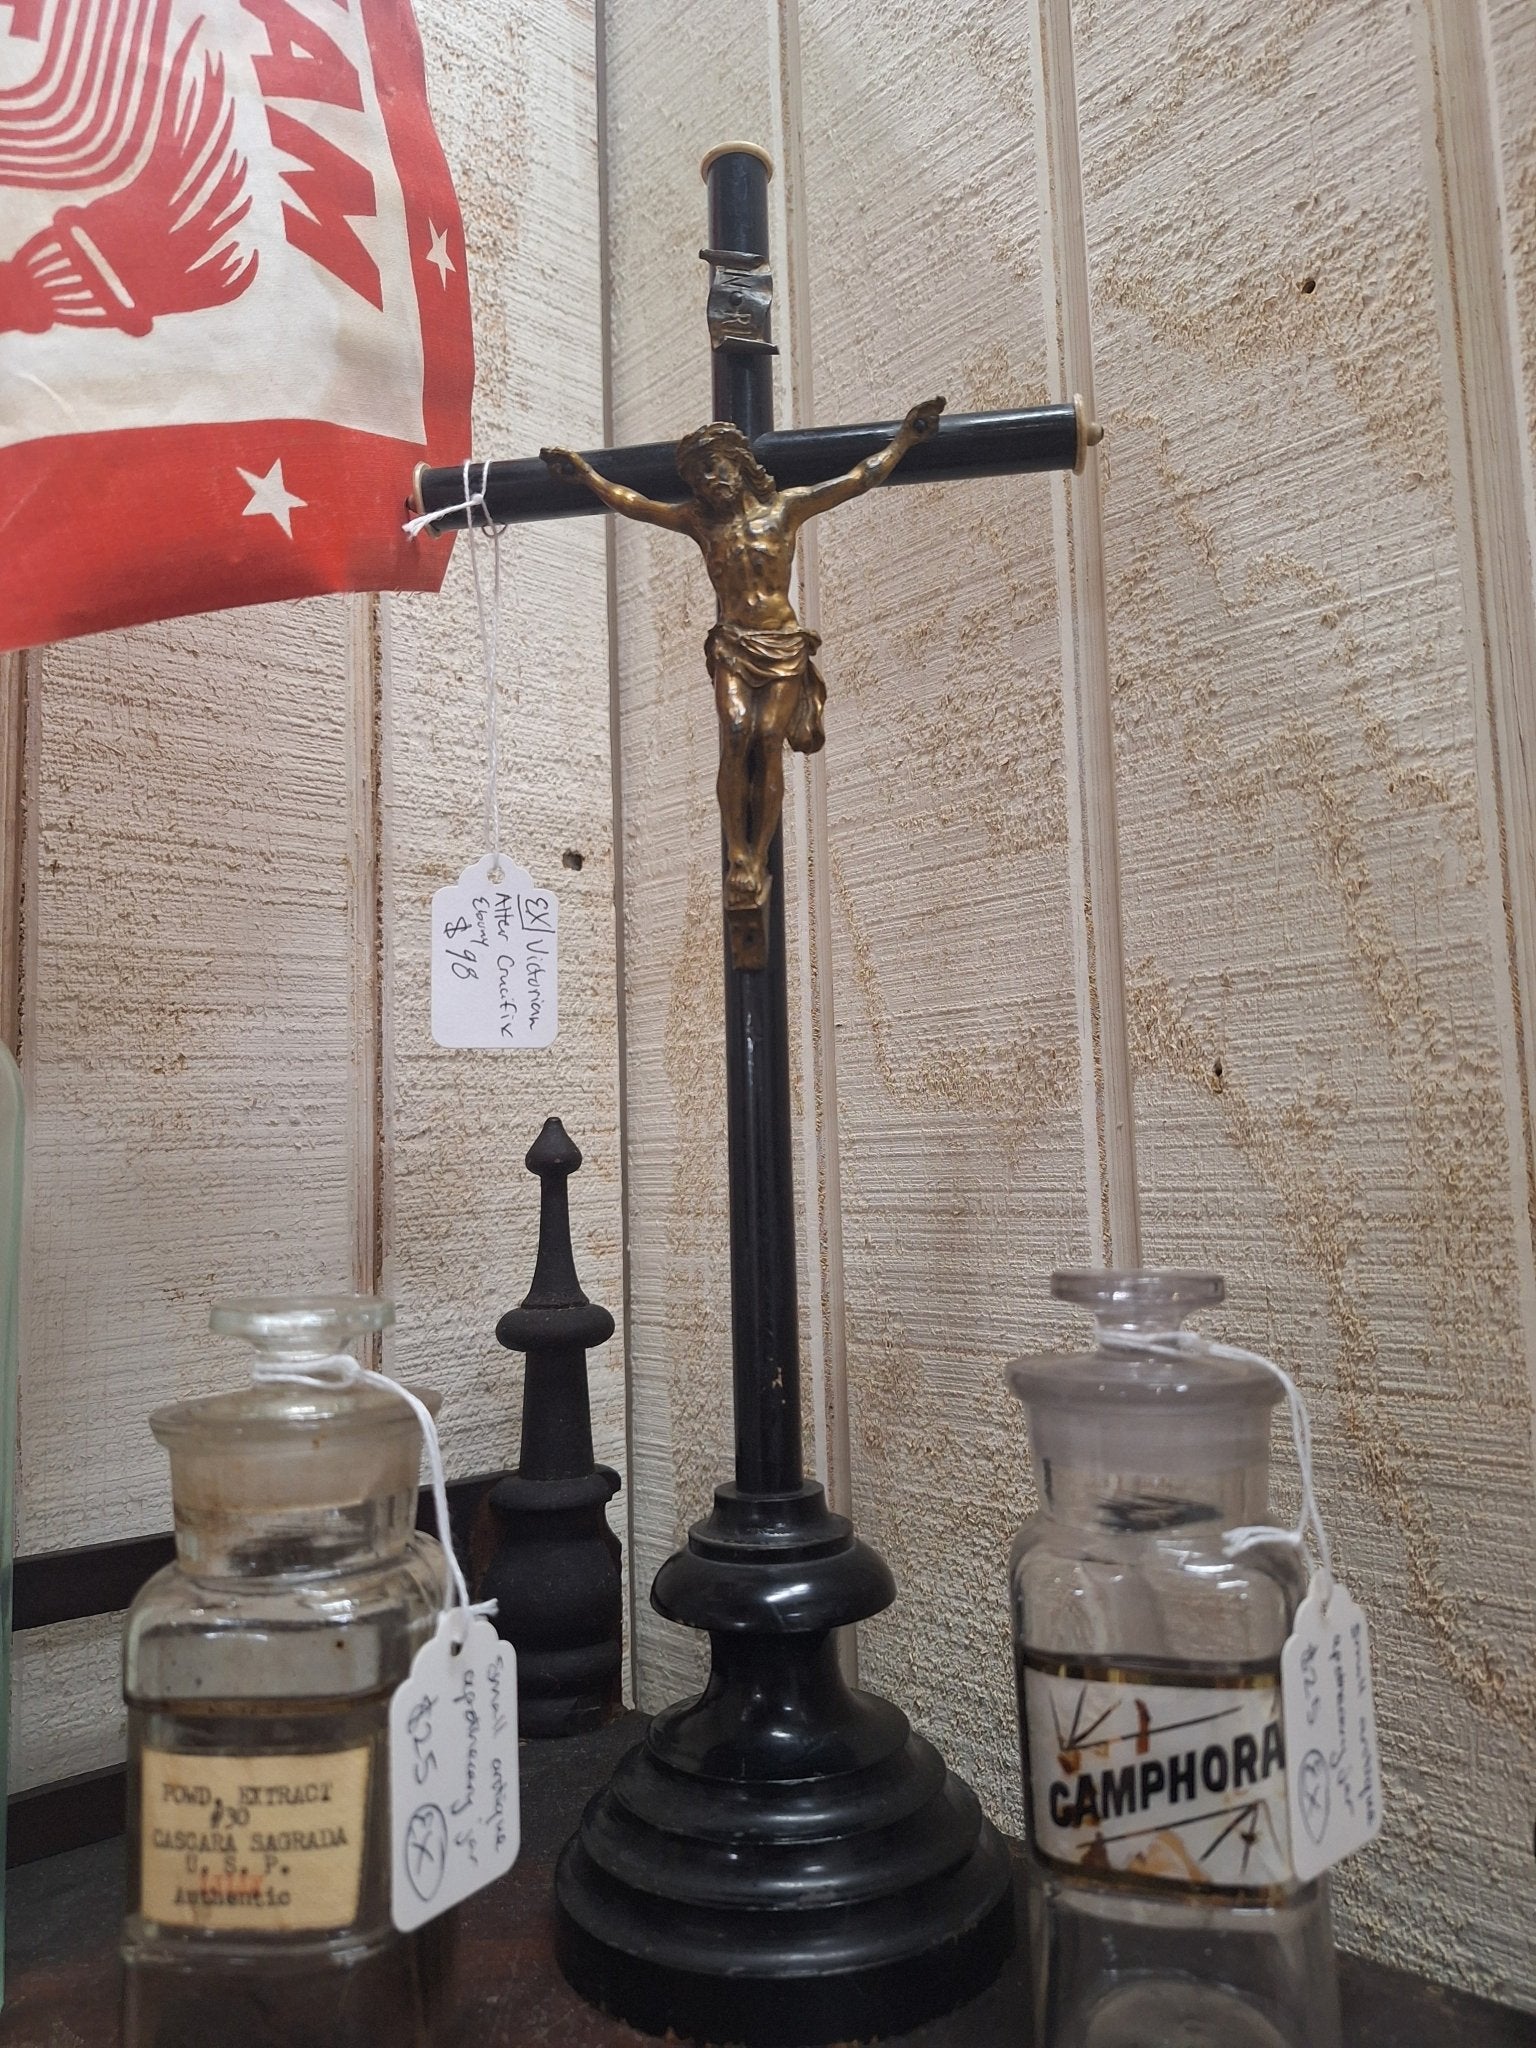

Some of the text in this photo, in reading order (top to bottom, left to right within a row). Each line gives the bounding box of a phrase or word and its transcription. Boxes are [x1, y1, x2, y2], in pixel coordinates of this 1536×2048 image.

[237, 0, 384, 312] AM
[472, 896, 490, 948] Ebony
[494, 892, 515, 942] Alter
[526, 938, 549, 1031] Victorian
[407, 1694, 438, 1785] $25
[238, 1782, 333, 1807] EXTRACT
[1050, 1721, 1286, 1828] CAMPHORA
[485, 1757, 507, 1853] antique
[153, 1826, 348, 1852] CASCARA SAGRADA
[454, 1817, 481, 1867] jar
[174, 1888, 291, 1907] Authentic
